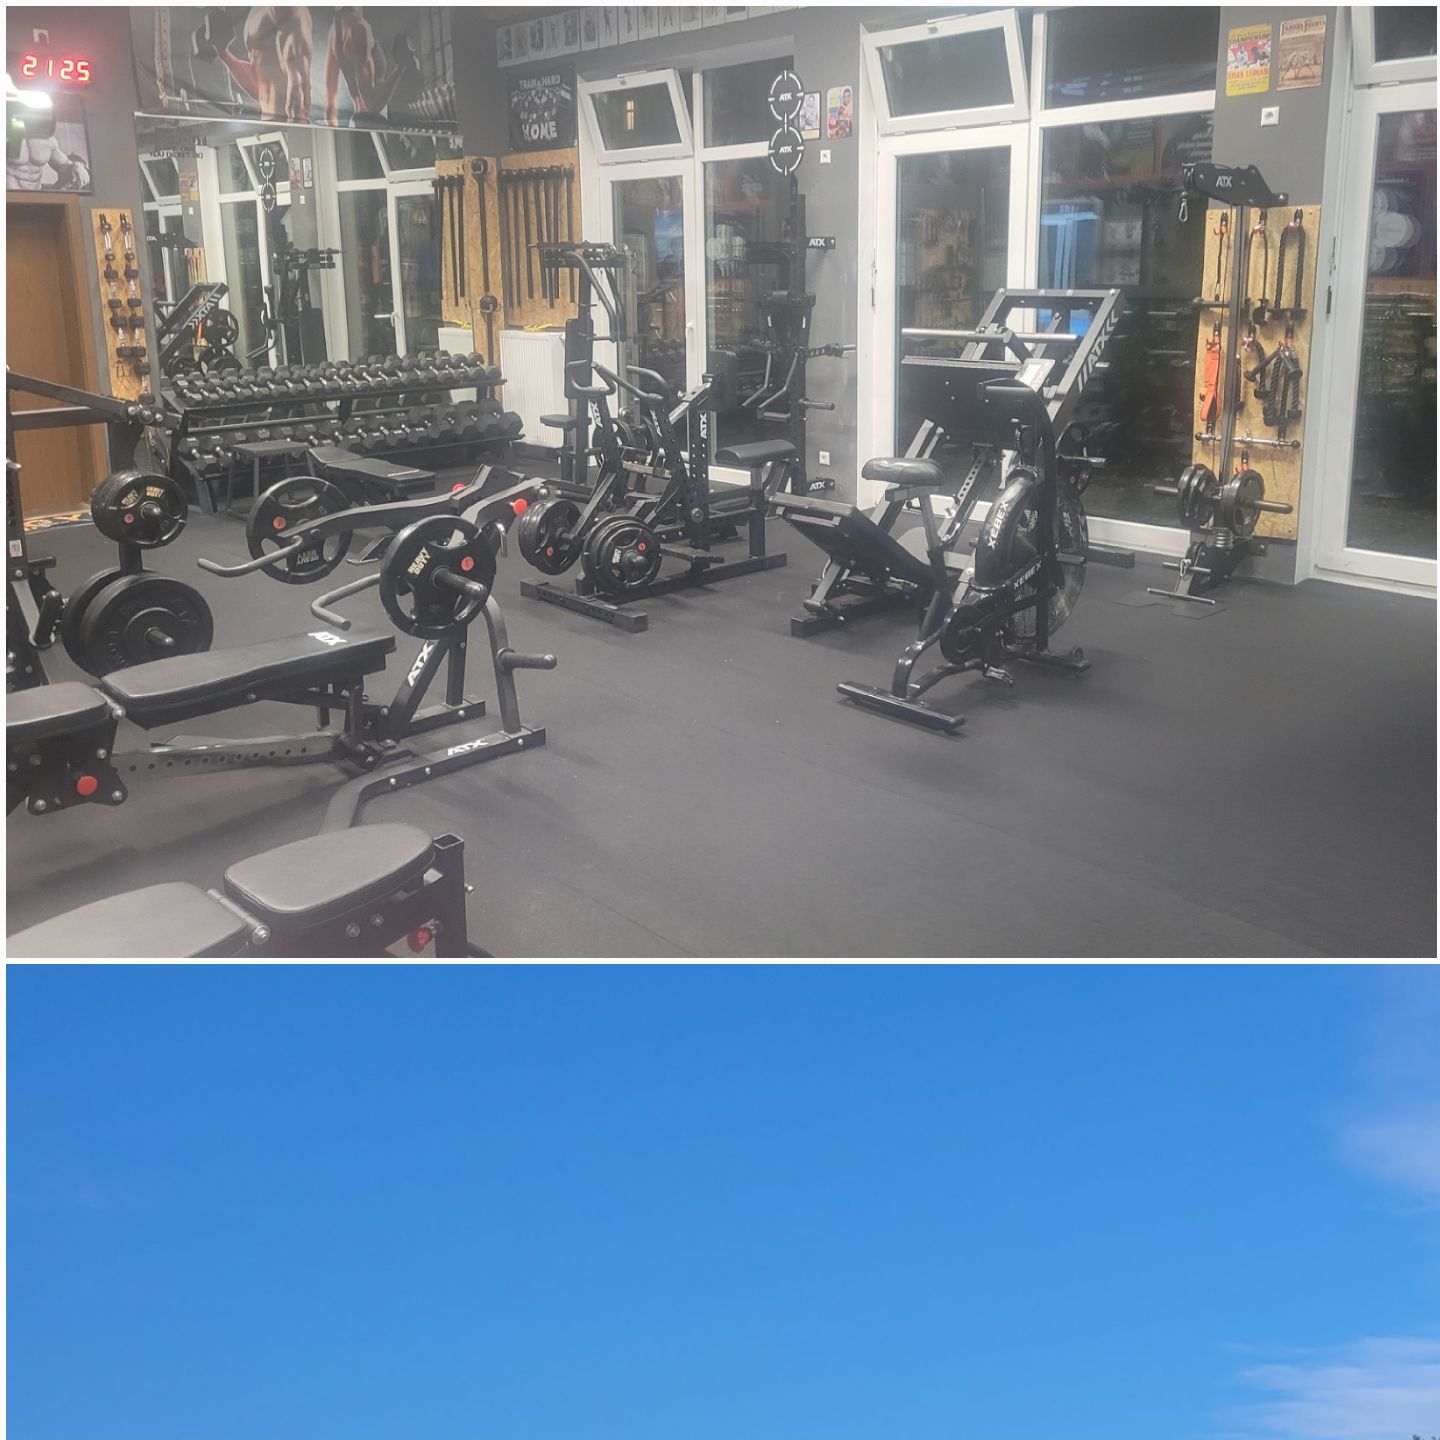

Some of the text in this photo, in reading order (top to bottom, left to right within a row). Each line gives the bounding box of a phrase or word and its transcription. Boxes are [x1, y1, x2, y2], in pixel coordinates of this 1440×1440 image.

[779, 92, 792, 101] ATX
[522, 121, 557, 140] HOME
[779, 145, 792, 154] ATX
[1216, 175, 1232, 187] ATX
[809, 238, 825, 247] ATX
[1087, 327, 1111, 374] ATX
[700, 412, 708, 440] ATX
[809, 481, 825, 492] ATX
[987, 501, 1009, 550] XEBEX
[307, 631, 349, 646] ATX
[407, 640, 435, 688] ATX
[447, 737, 489, 756] ATX
